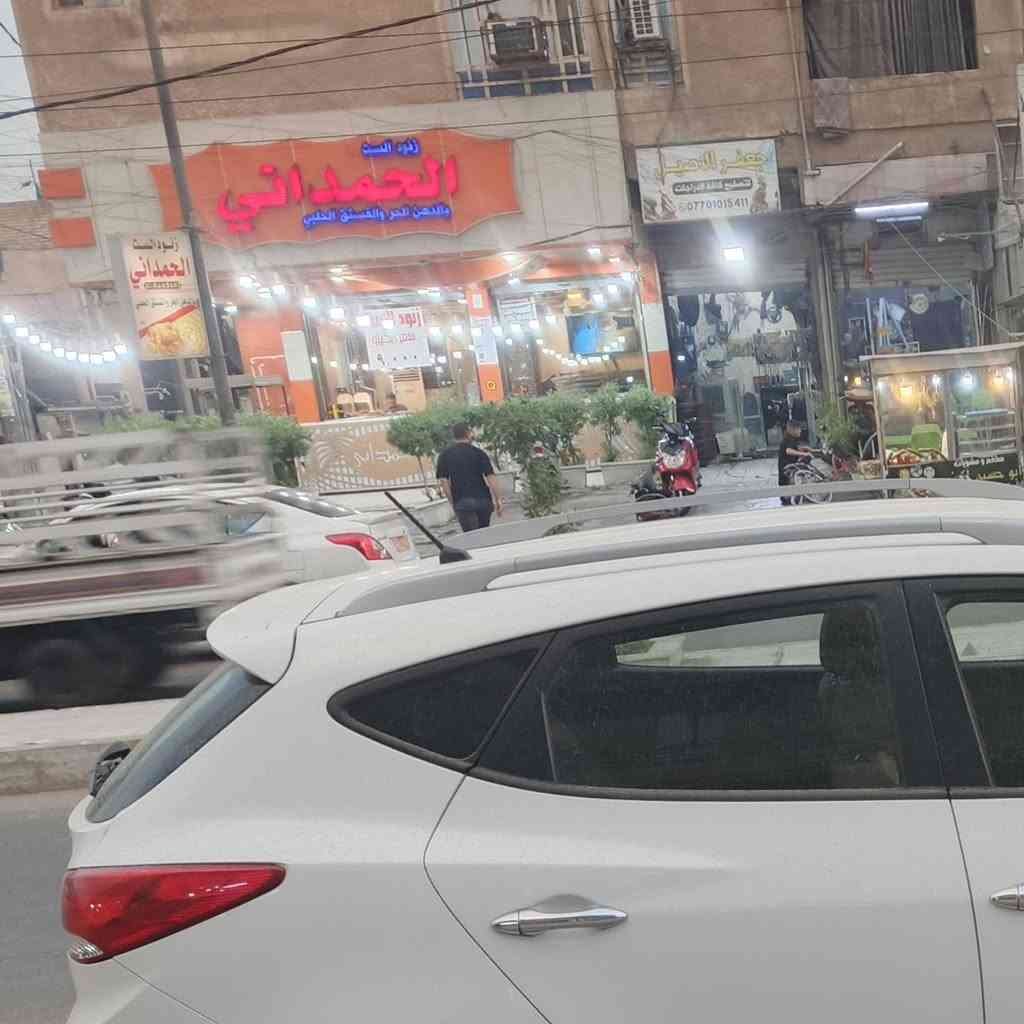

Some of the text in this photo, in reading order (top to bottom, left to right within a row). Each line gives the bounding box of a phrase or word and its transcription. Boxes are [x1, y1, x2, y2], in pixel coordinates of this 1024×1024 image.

[217, 154, 459, 234] الحمداني
[687, 197, 749, 210] 07701015411
[129, 255, 194, 289] الحمداني
